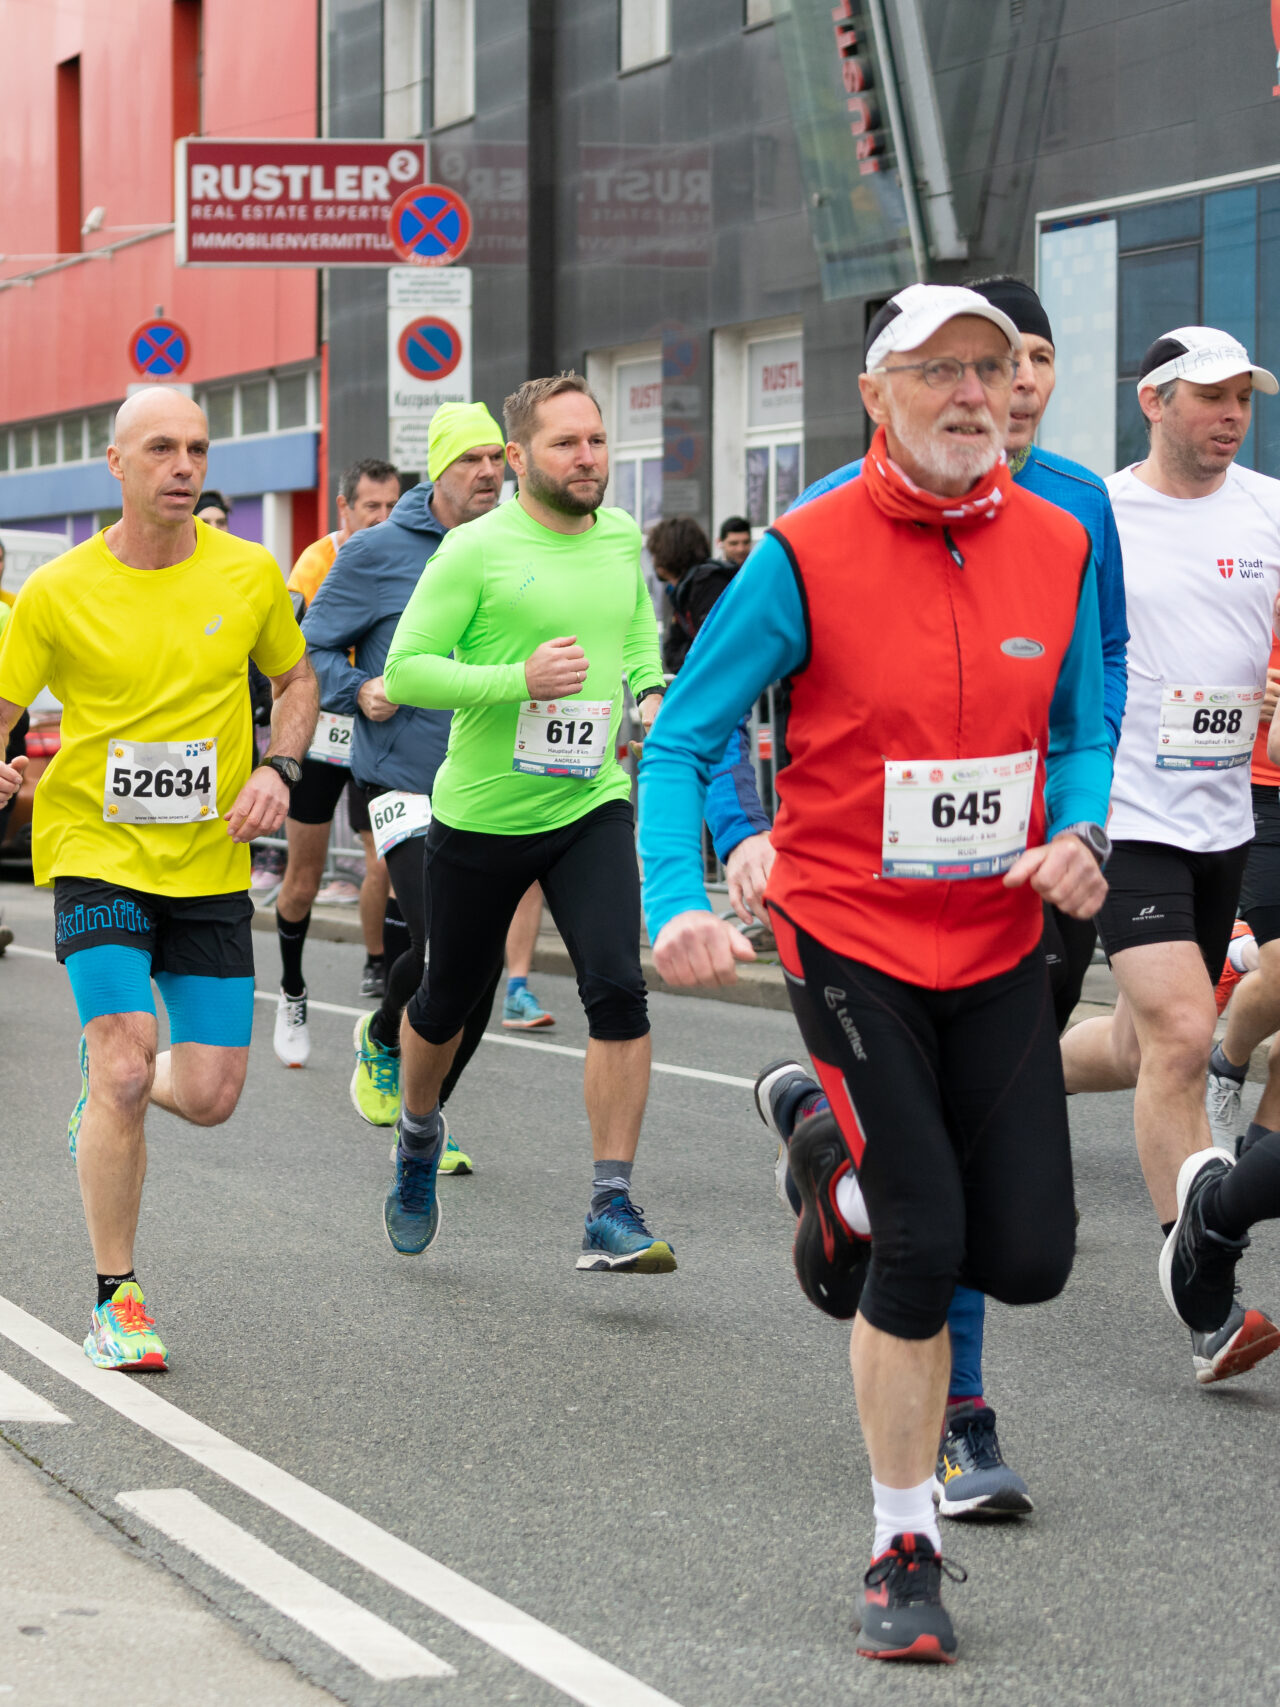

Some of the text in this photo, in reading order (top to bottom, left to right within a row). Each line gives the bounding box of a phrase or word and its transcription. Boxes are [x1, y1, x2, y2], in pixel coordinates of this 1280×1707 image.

[191, 165, 391, 201] RUSTLER
[192, 204, 392, 221] REAL ESTATE EXPERTS
[1238, 558, 1263, 568] Stadt
[1239, 569, 1265, 579] Wien
[546, 719, 594, 745] 612
[1192, 708, 1243, 734] 688
[328, 727, 353, 745] 62
[112, 765, 211, 798] 52634
[374, 801, 407, 830] 602
[931, 788, 1001, 828] 645
[935, 833, 974, 844] Hauptlauf
[957, 848, 977, 857] RUDI
